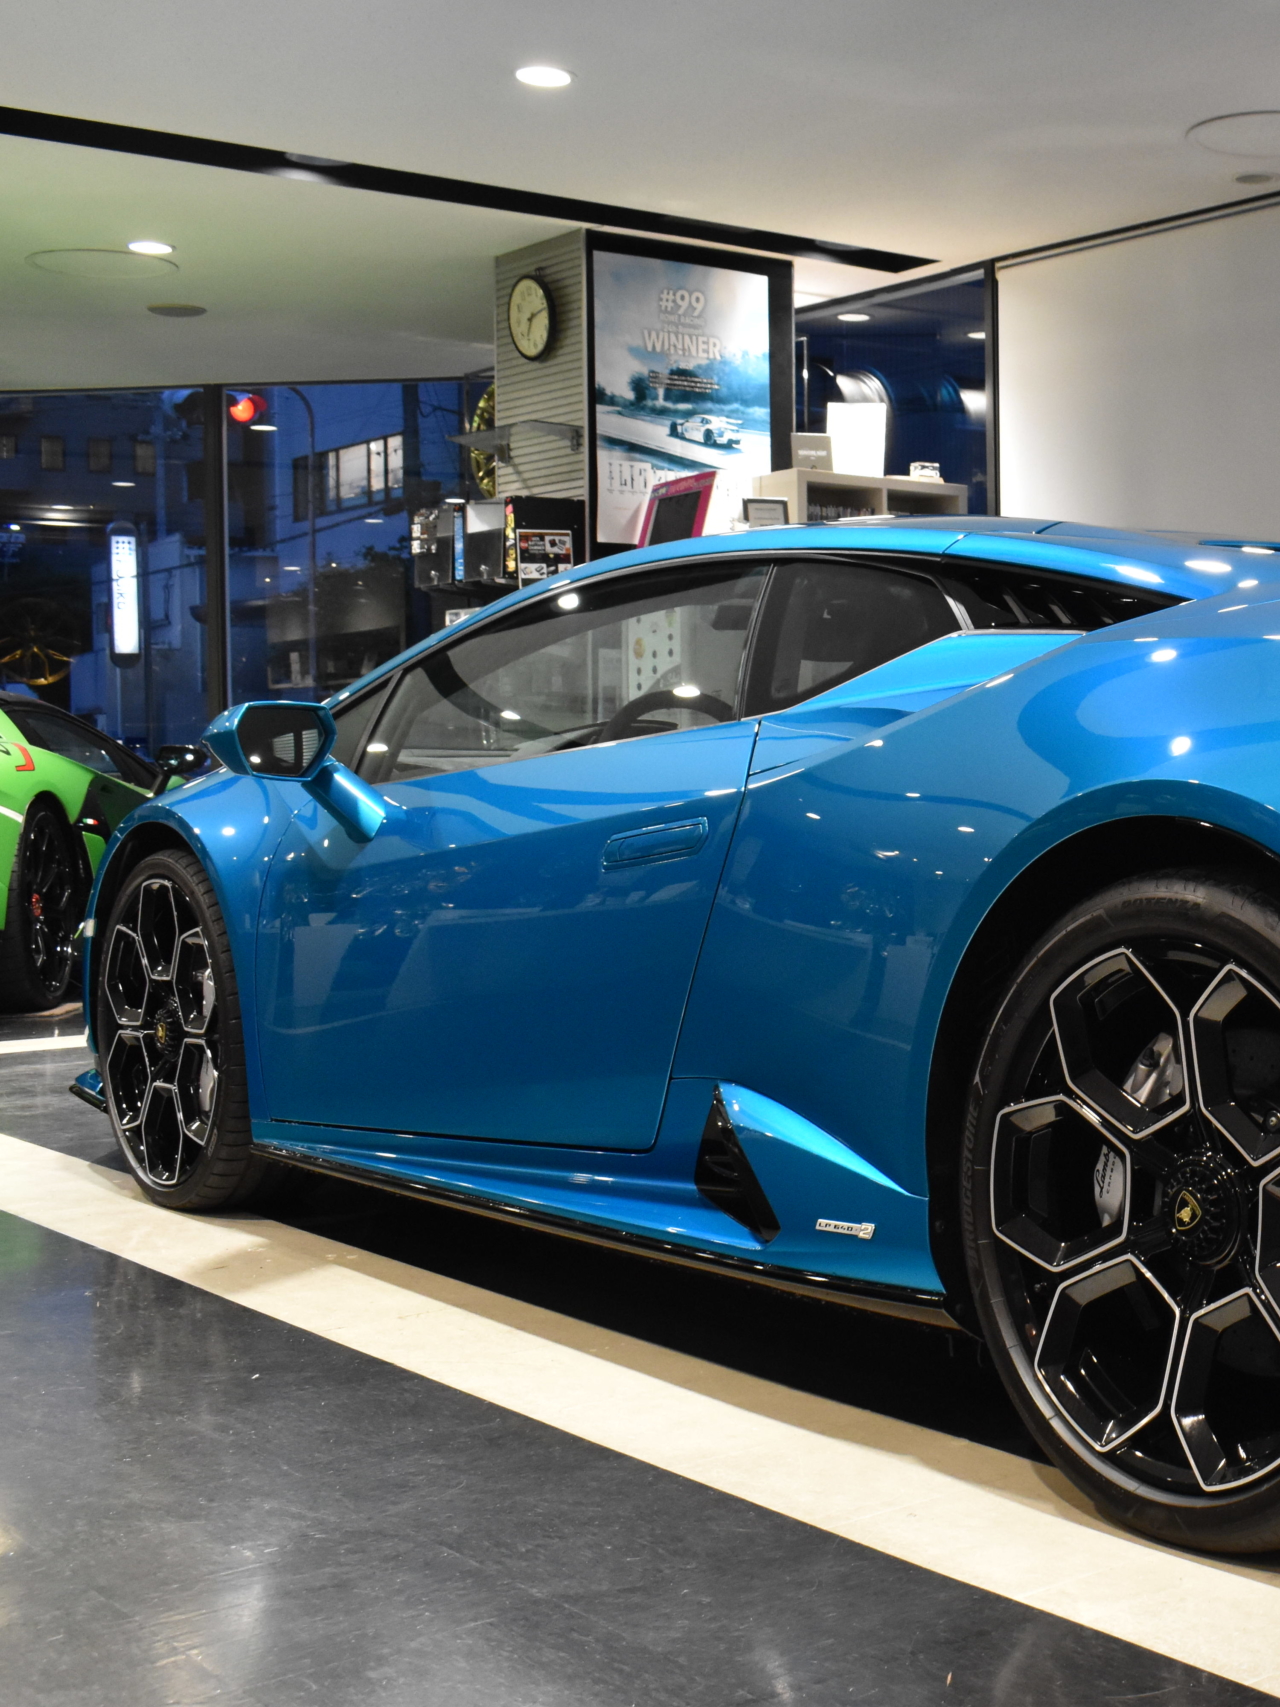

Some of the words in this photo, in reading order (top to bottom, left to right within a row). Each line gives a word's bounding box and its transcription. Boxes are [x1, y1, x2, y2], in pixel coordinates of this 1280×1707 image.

[659, 289, 705, 316] #99
[643, 329, 721, 360] WINNER
[1120, 896, 1202, 913] POTENZA
